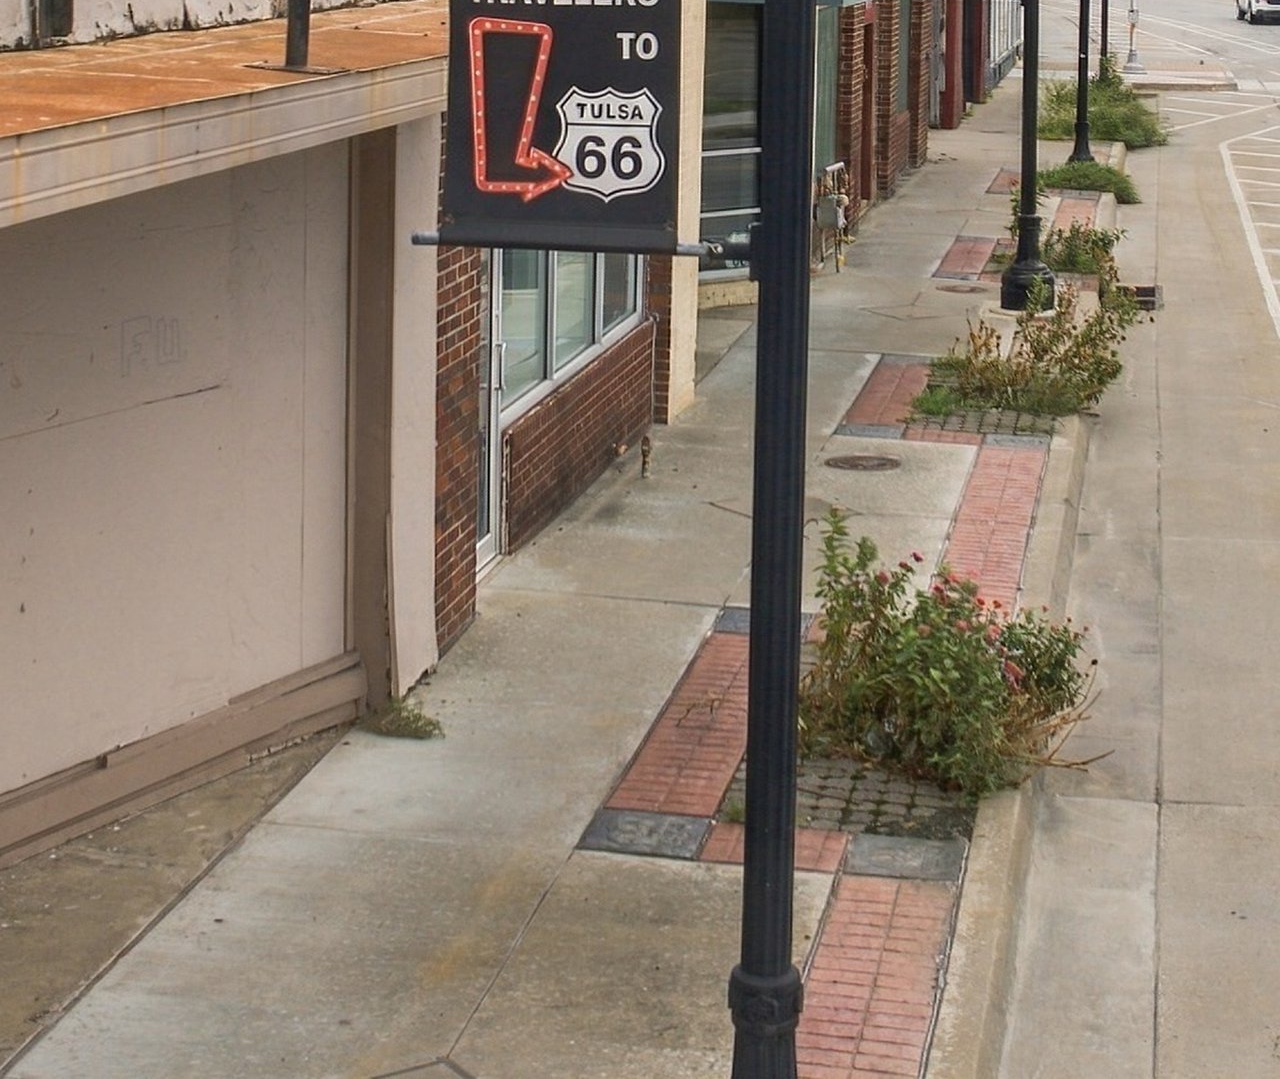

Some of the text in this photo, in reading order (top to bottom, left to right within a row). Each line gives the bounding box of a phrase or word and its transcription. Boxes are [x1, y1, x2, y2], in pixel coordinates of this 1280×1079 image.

[616, 32, 659, 60] TO
[575, 102, 644, 121] TULSA
[575, 135, 643, 179] 66
